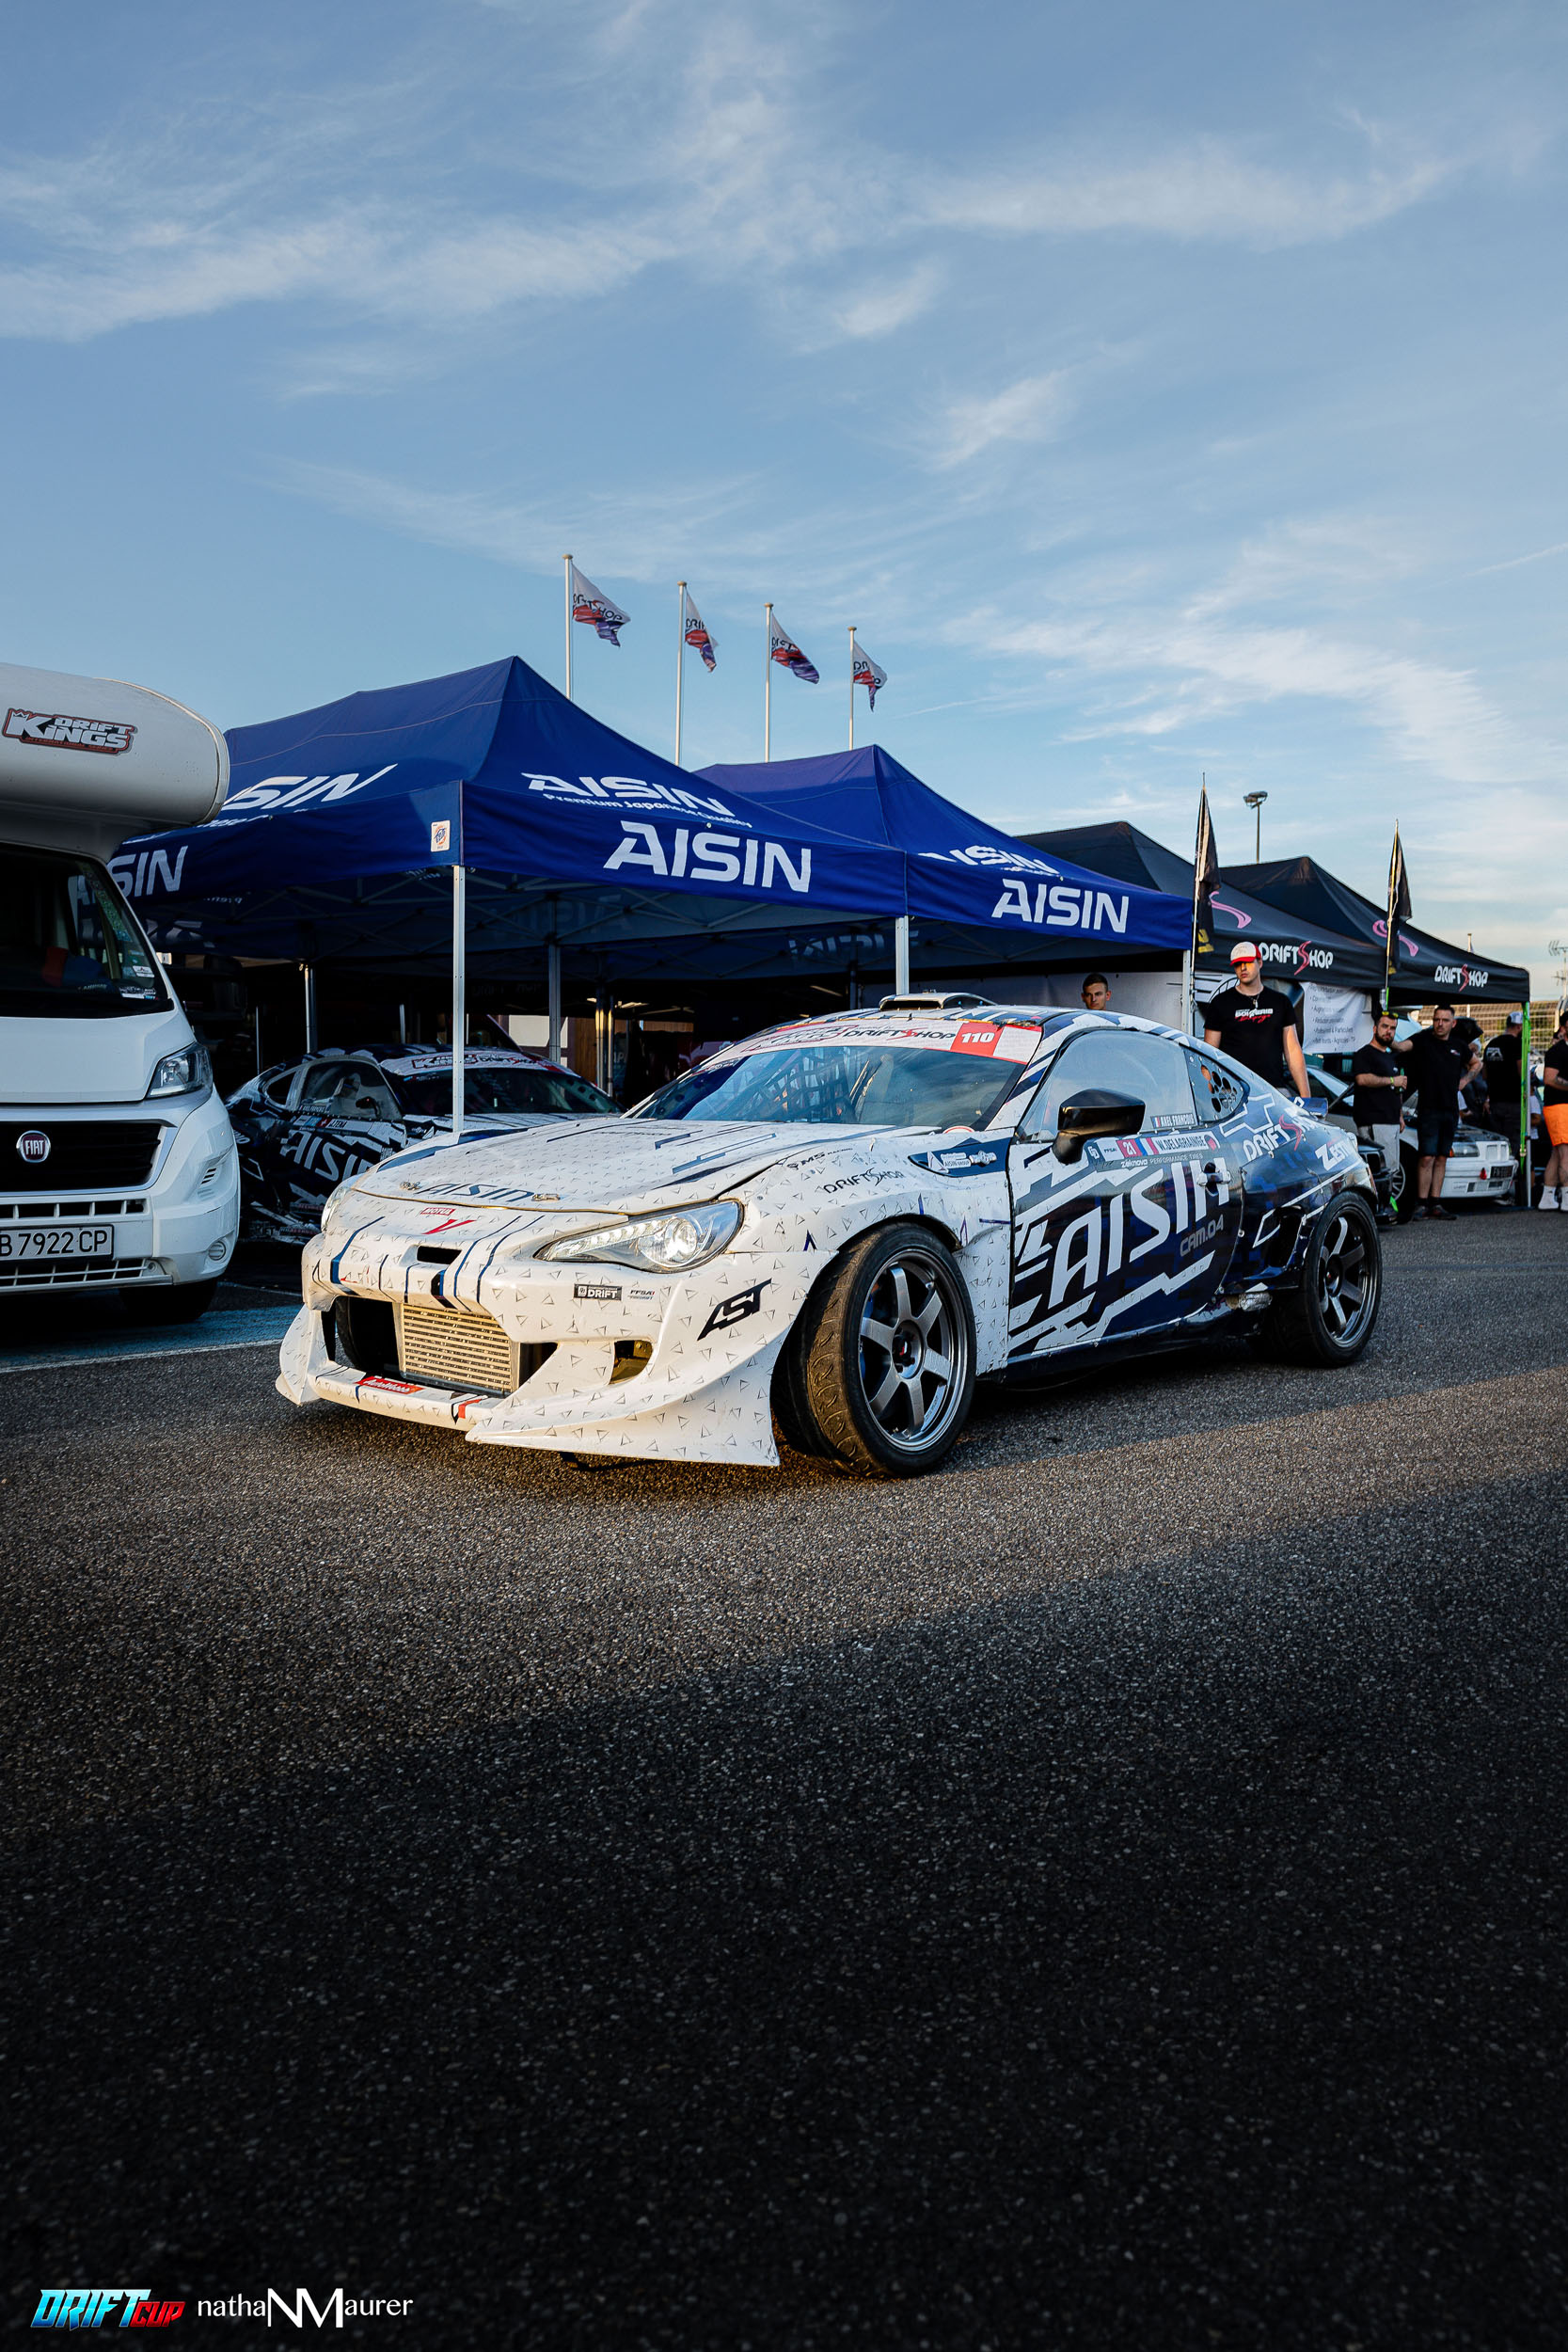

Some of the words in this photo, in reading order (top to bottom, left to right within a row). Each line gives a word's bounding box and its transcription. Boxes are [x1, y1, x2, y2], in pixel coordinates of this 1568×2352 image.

[54, 717, 133, 734] DRIFT
[221, 763, 398, 810] SIN
[521, 772, 736, 817] AISIN
[543, 793, 623, 808] Premium
[603, 820, 812, 893] AISIN
[106, 846, 188, 898] SIN
[990, 878, 1130, 934] AISIN
[1259, 941, 1334, 976] DRIFTSHOP
[1434, 963, 1488, 993] DRIFTSHOP
[960, 1031, 995, 1043] 110
[25, 1140, 44, 1155] FIAT
[824, 1168, 905, 1194] DRIFTSHOP
[18, 1232, 74, 1256] 7922
[79, 1230, 108, 1253] CP
[1180, 1215, 1224, 1257] CAM.04
[587, 1289, 618, 1299] DRIFT
